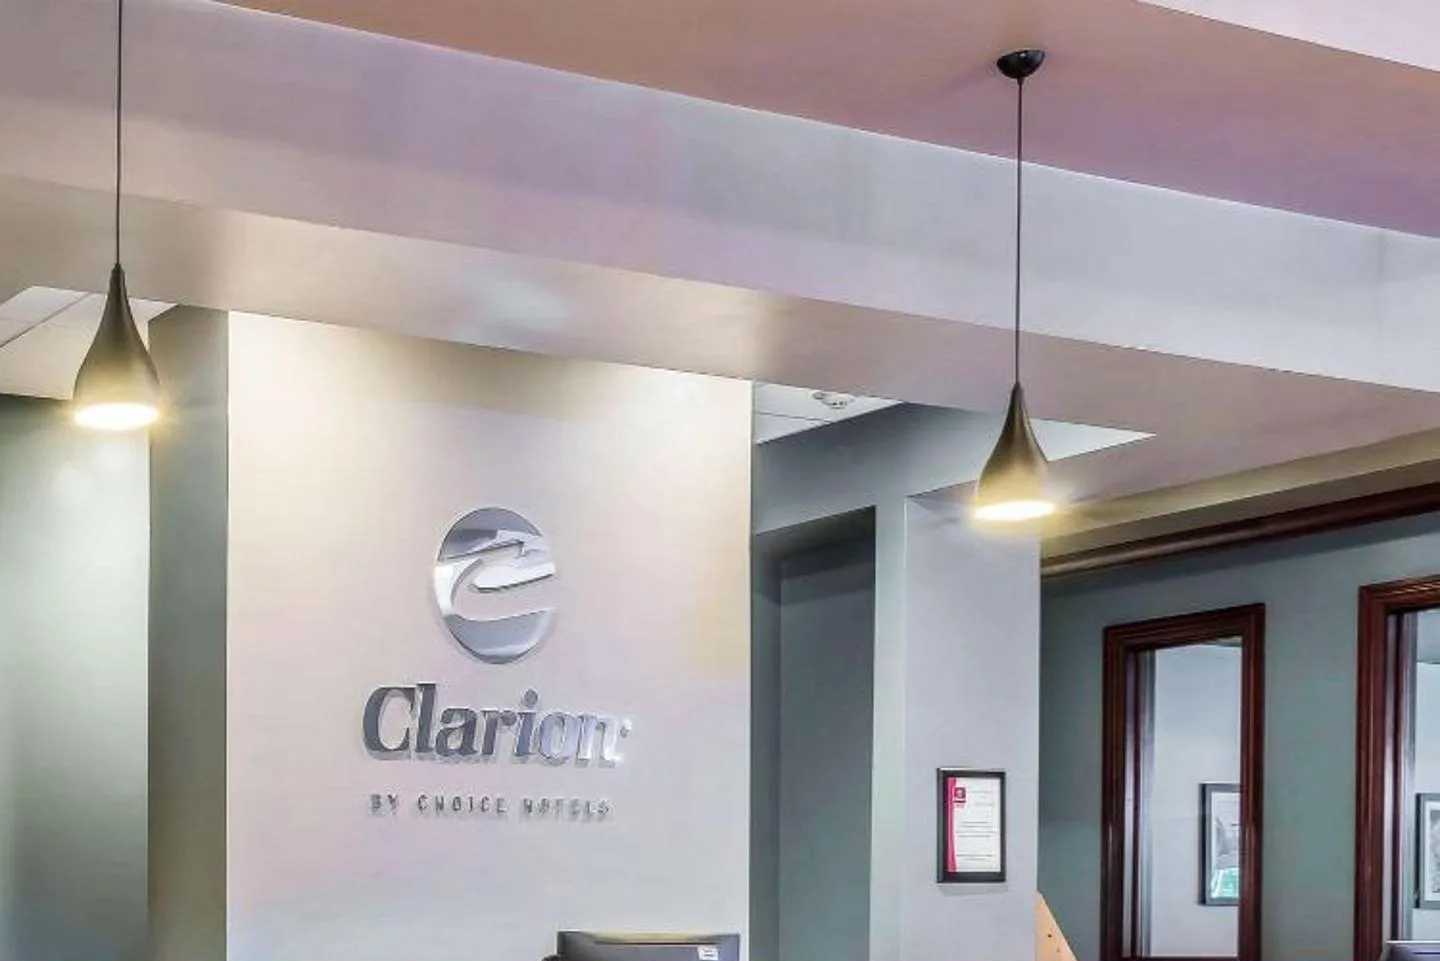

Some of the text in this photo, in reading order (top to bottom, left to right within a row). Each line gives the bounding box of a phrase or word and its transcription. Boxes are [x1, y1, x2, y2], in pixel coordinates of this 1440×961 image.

[362, 682, 627, 763] Clarion
[370, 793, 398, 814] BY
[417, 794, 508, 814] CHOICE
